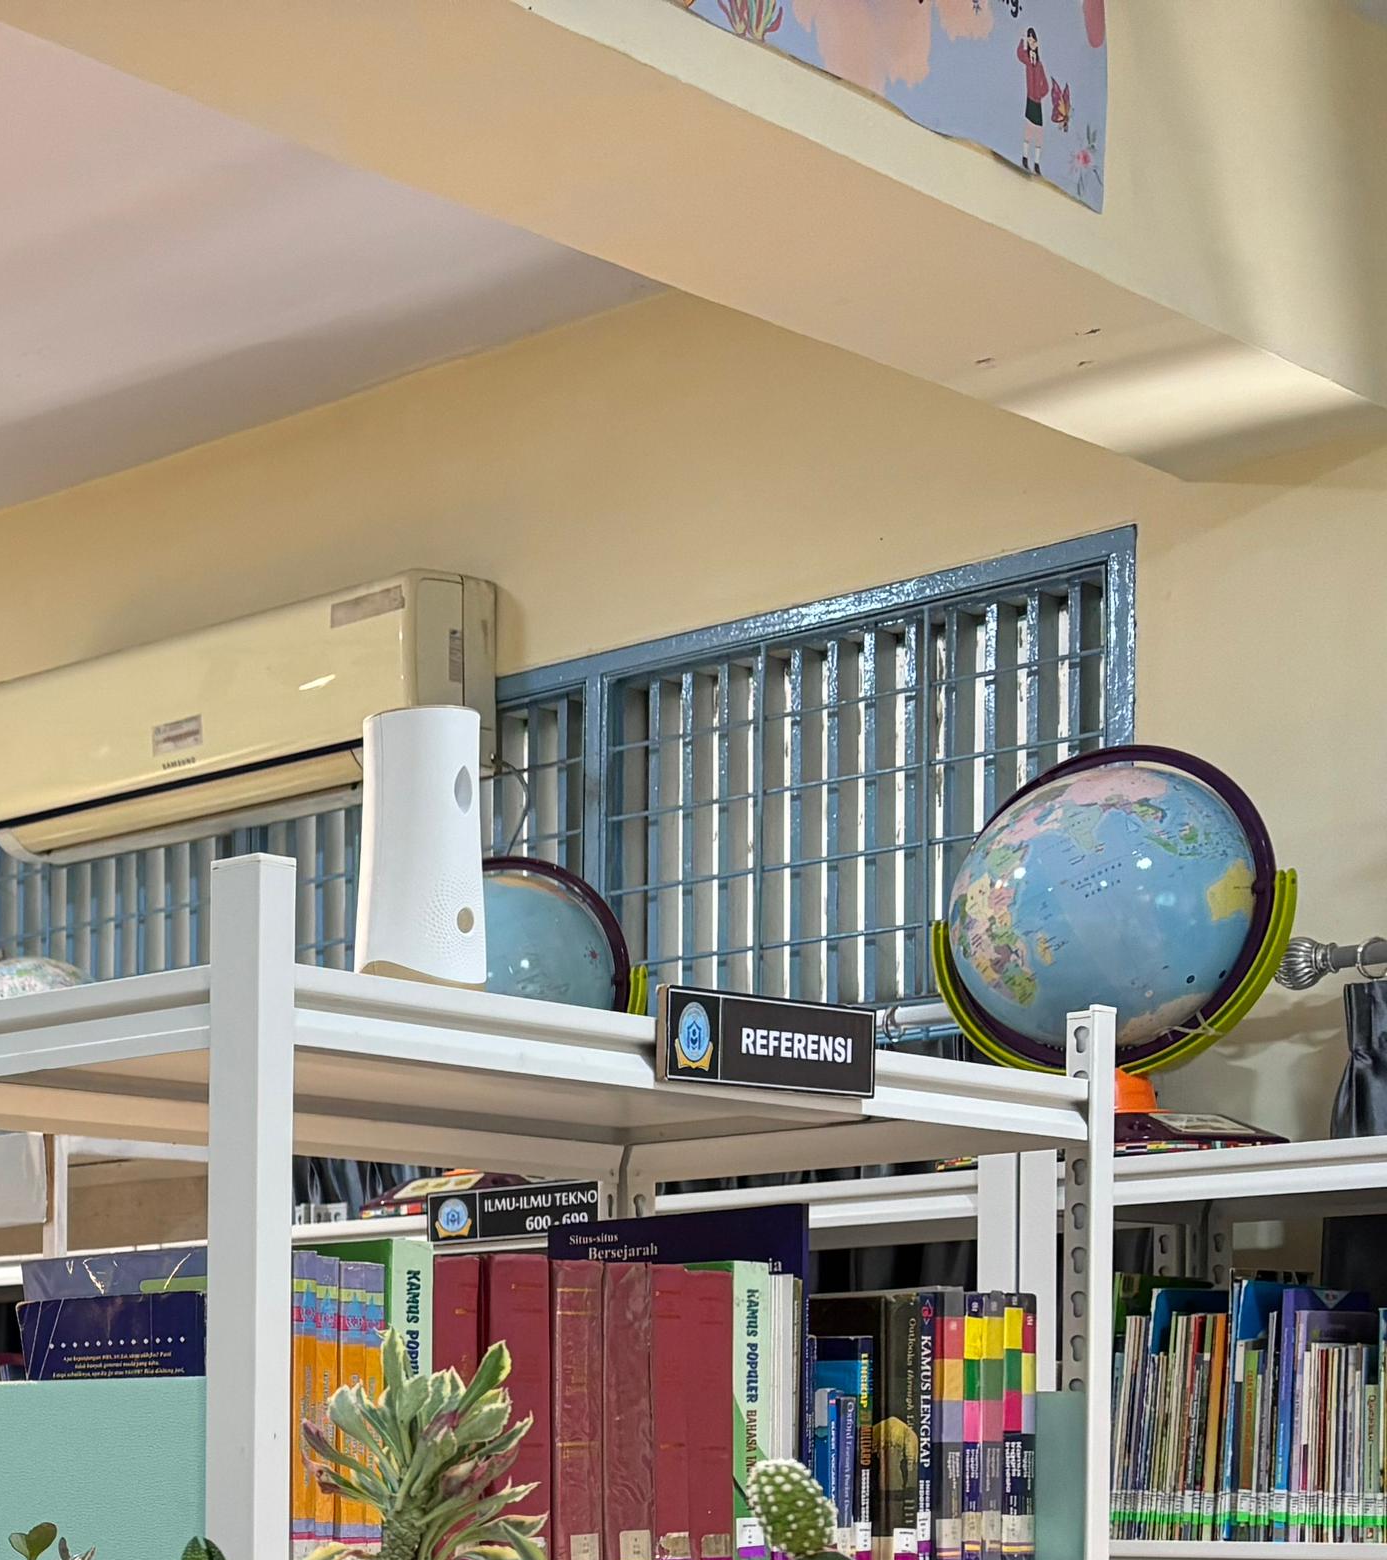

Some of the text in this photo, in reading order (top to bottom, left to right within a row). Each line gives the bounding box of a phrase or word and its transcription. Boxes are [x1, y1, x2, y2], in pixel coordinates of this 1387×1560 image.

[740, 1027, 854, 1064] REFERENSI
[483, 1189, 598, 1212] ILMU-ILMU TEKNO
[525, 1214, 553, 1231] 600
[568, 1233, 619, 1245] Situs-situs
[588, 1242, 659, 1261] Bersejarah
[406, 1269, 421, 1324] KAMUS
[745, 1288, 760, 1452] KAMUS POPULER BAHASA
[919, 1335, 932, 1468] KAMUS LENGKAP
